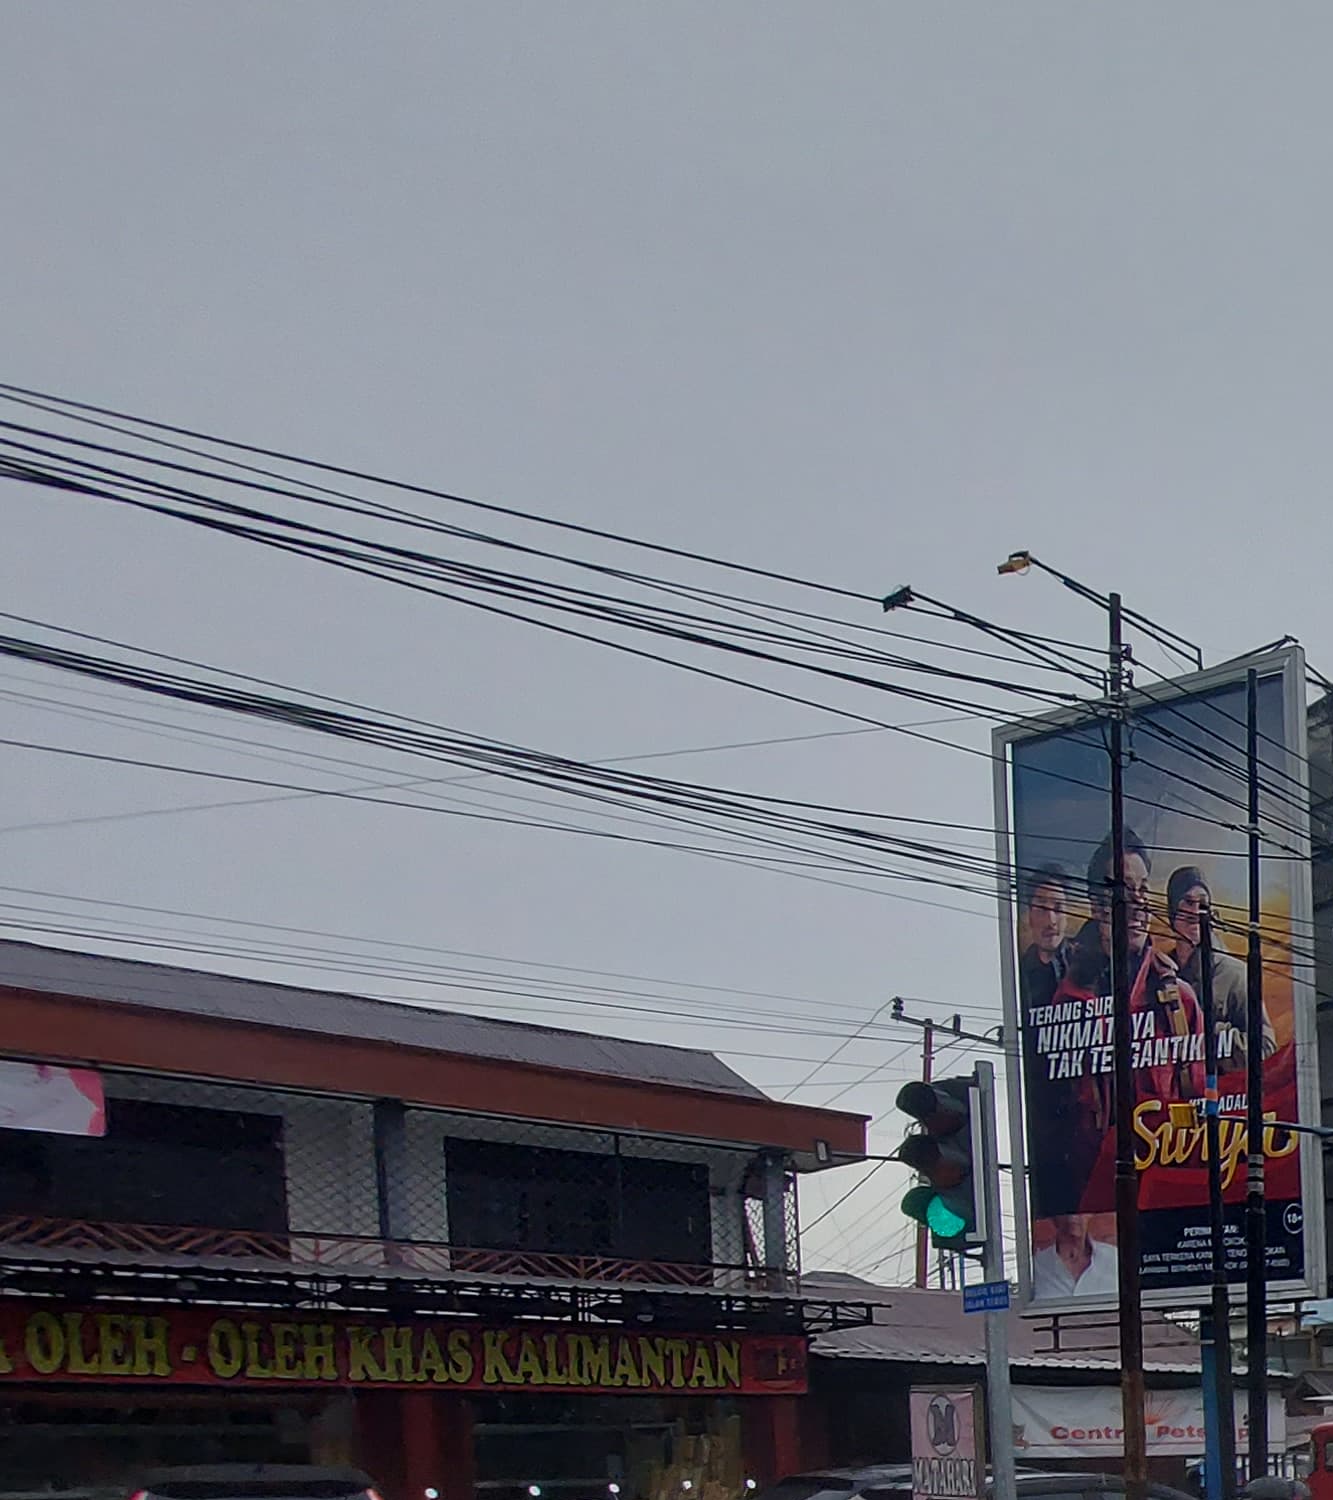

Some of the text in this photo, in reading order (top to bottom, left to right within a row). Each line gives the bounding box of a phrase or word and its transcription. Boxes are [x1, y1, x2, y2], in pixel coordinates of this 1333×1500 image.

[1029, 1000, 1081, 1026] TERANG
[1037, 1010, 1155, 1054] NIKMATYA
[1048, 1050, 1083, 1081] TAK
[24, 1311, 173, 1377] OLEH
[207, 1318, 338, 1381] OLEH
[346, 1325, 472, 1384] KHAS
[482, 1330, 742, 1388] KALIMANTAN
[913, 1457, 977, 1497] MATAHARI
